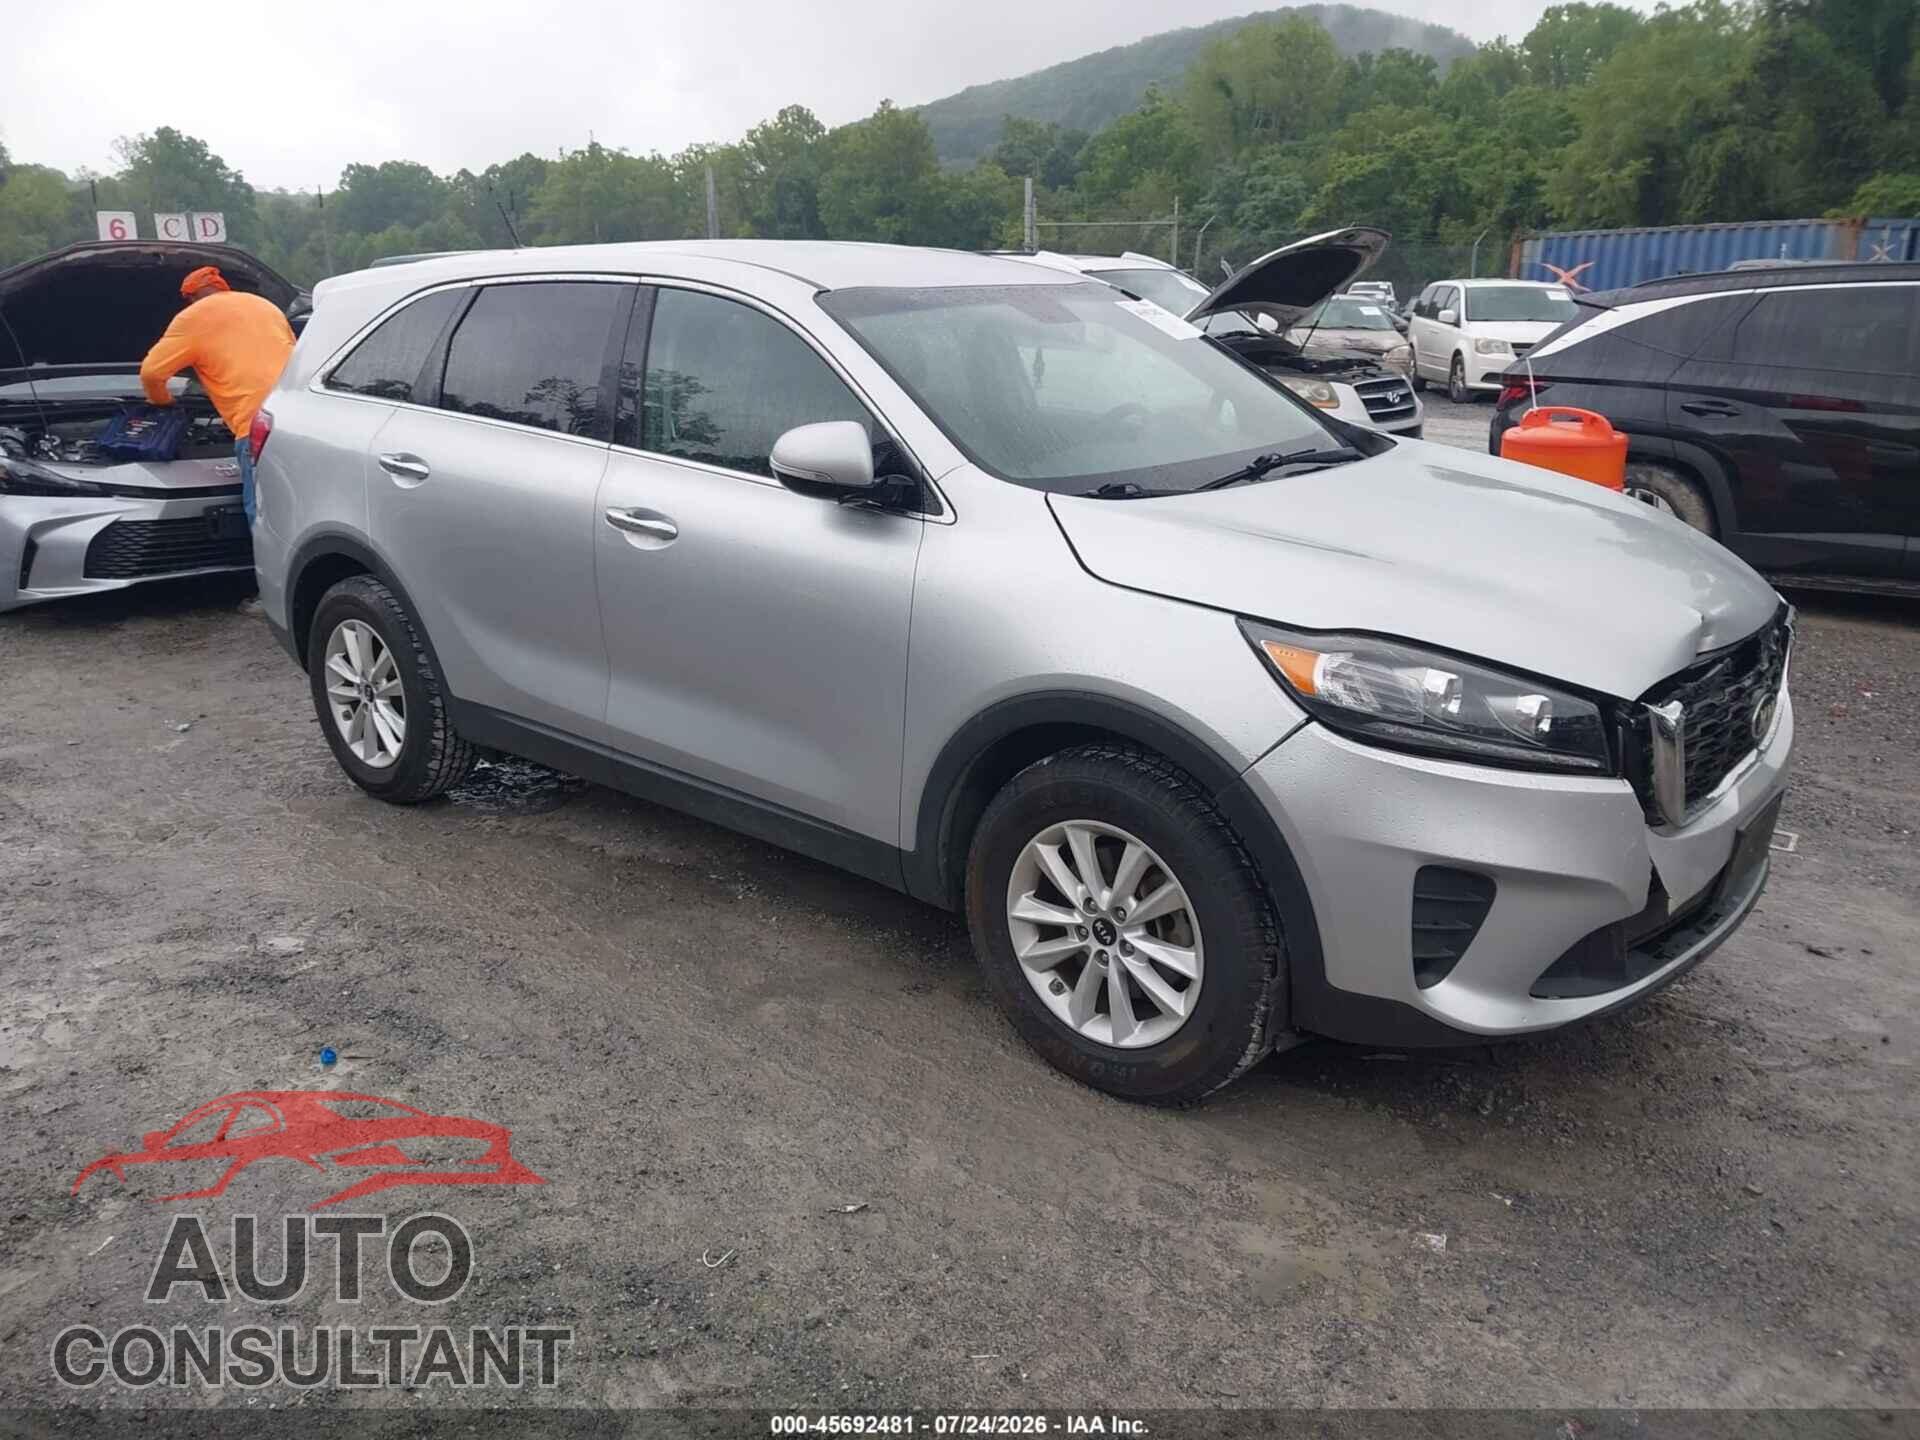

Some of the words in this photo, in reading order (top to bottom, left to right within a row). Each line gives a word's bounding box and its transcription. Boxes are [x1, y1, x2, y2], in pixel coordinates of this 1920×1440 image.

[110, 218, 126, 240] 6
[164, 218, 181, 238] C
[201, 218, 219, 237] D
[1095, 921, 1111, 945] KIA
